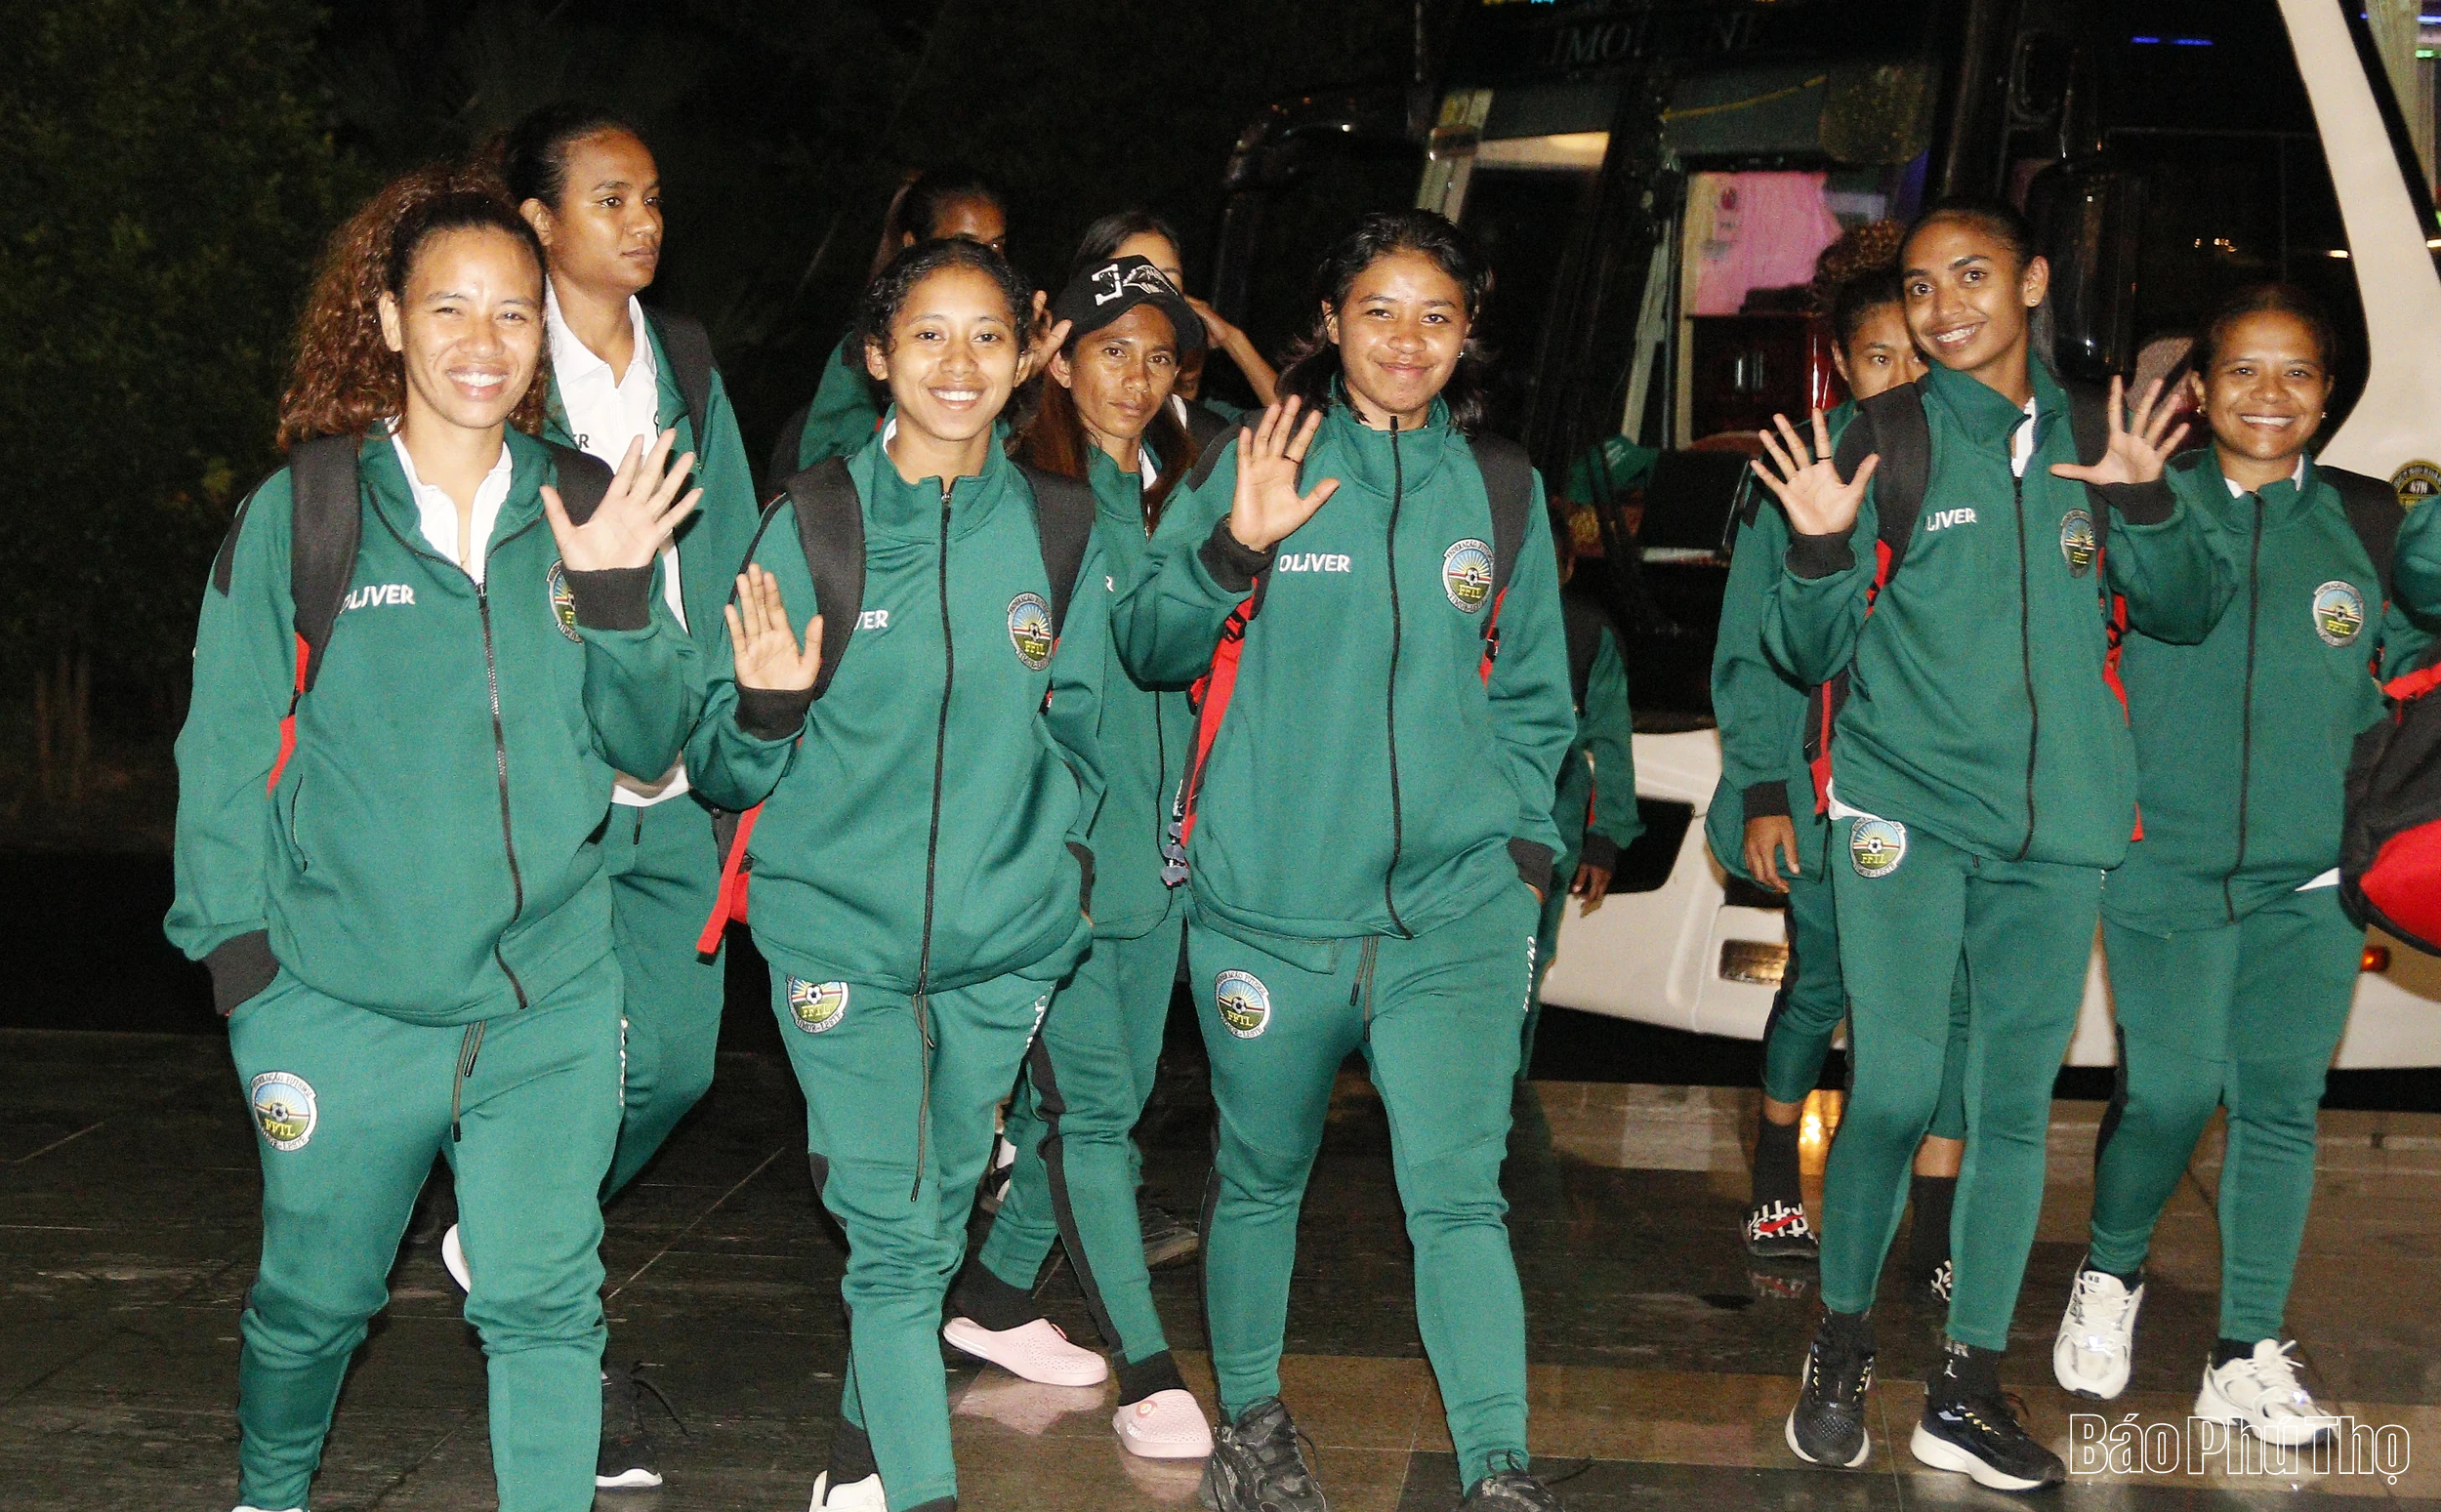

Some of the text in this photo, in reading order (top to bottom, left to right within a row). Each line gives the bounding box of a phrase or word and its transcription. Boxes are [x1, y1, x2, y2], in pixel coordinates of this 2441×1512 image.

[1924, 507, 1977, 532] LiVER
[1860, 853, 1888, 865] FFTL
[801, 1002, 832, 1019] FFTL
[1226, 1009, 1255, 1028] FFTL
[796, 1010, 843, 1033] TIMOR-LESTE
[264, 1118, 296, 1137] FFTL
